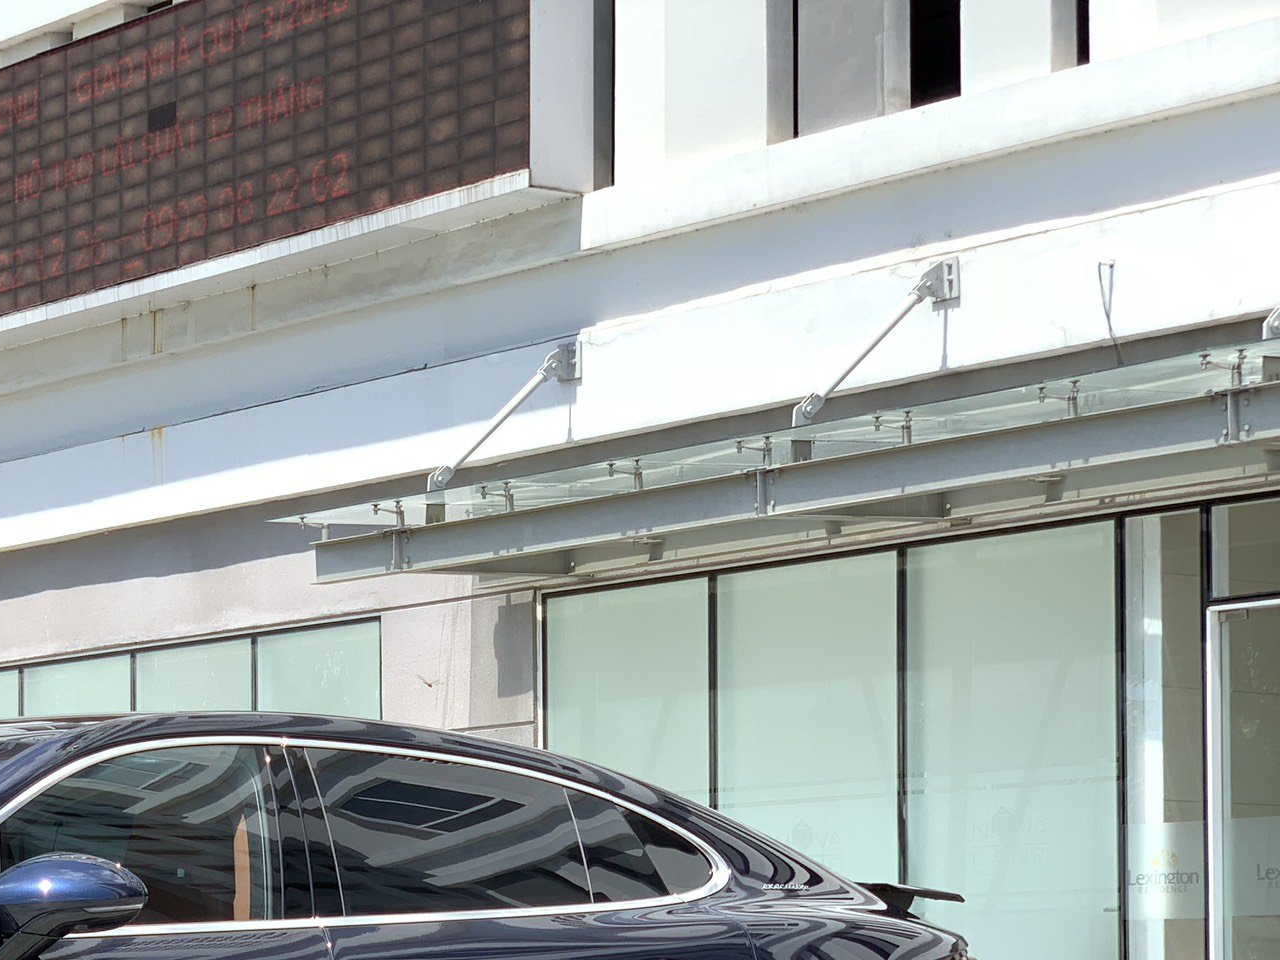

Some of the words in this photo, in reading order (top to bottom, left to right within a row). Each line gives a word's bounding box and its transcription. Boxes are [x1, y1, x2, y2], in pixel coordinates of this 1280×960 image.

[76, 57, 133, 102] GIAO
[267, 167, 301, 217] 22
[1127, 869, 1199, 887] Lexington
